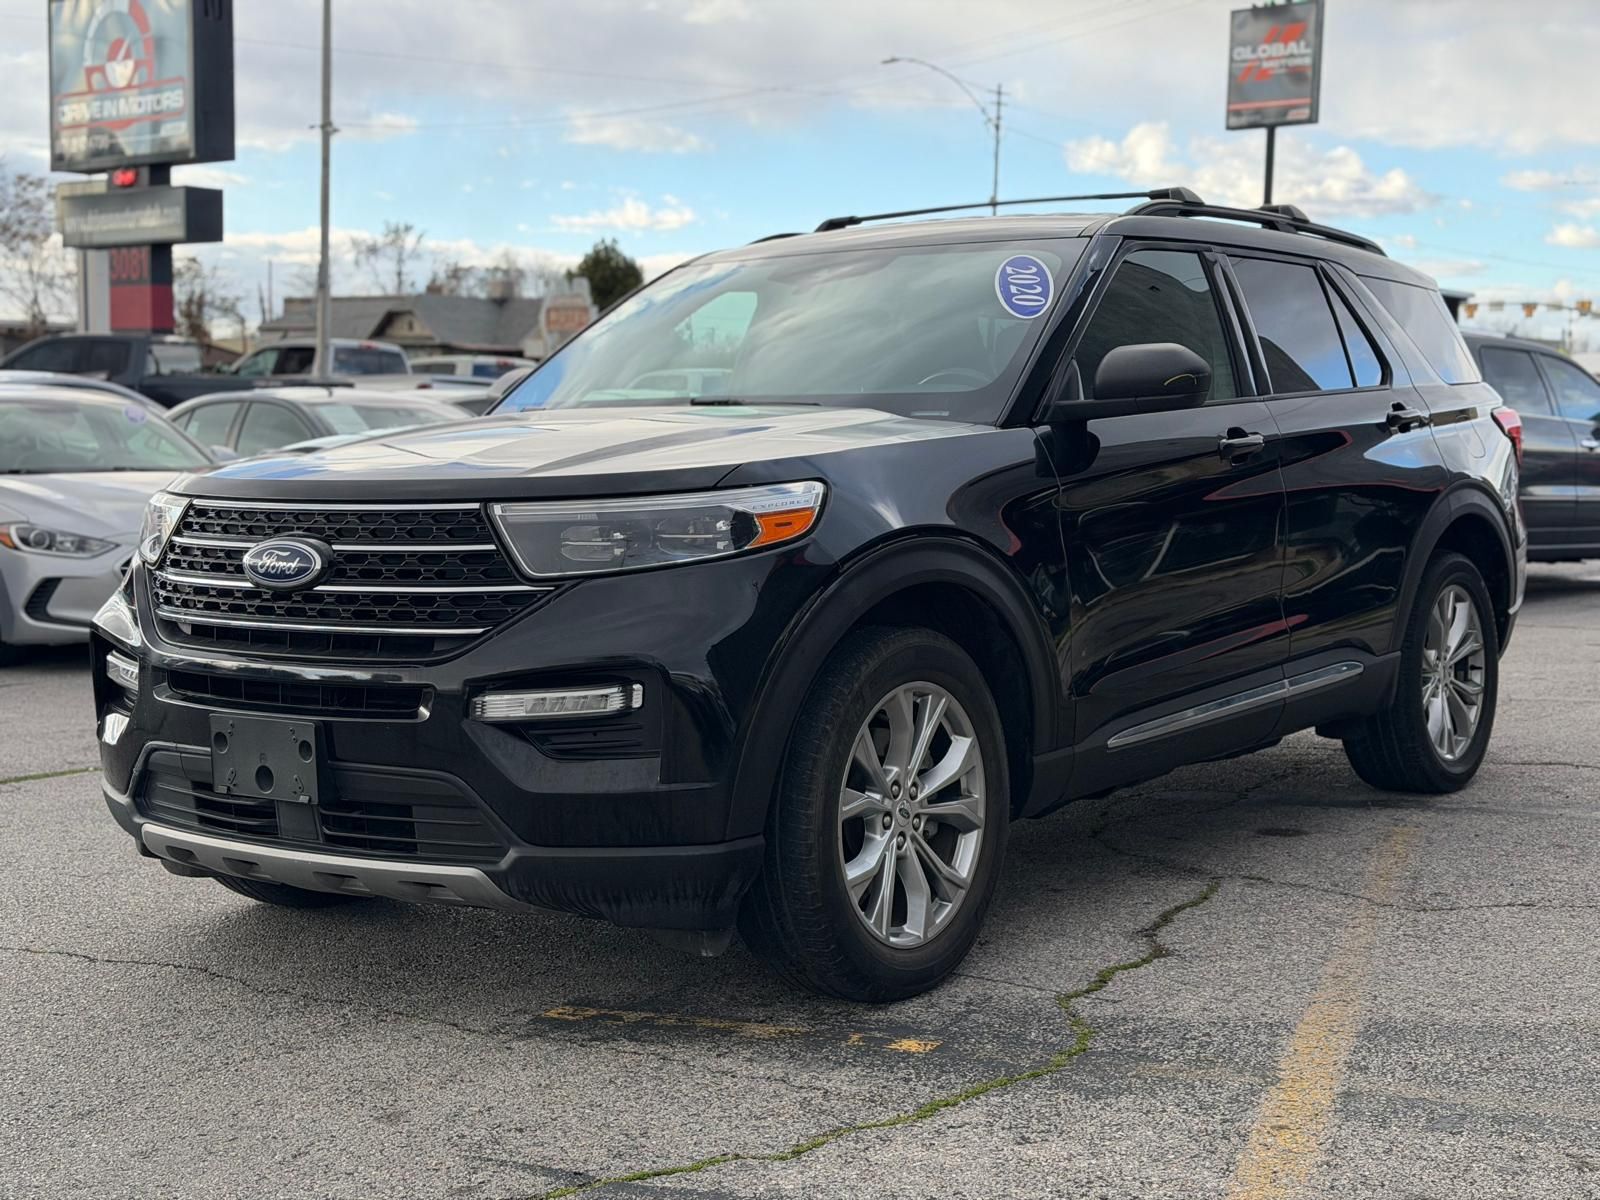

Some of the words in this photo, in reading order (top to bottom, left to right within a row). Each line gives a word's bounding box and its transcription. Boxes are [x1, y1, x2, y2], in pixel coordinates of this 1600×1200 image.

[1232, 40, 1312, 60] GLOBAL
[118, 88, 184, 117] MOTORS
[1005, 265, 1046, 306] 2020
[752, 499, 809, 510] EXPLORER
[258, 549, 300, 575] Ford
